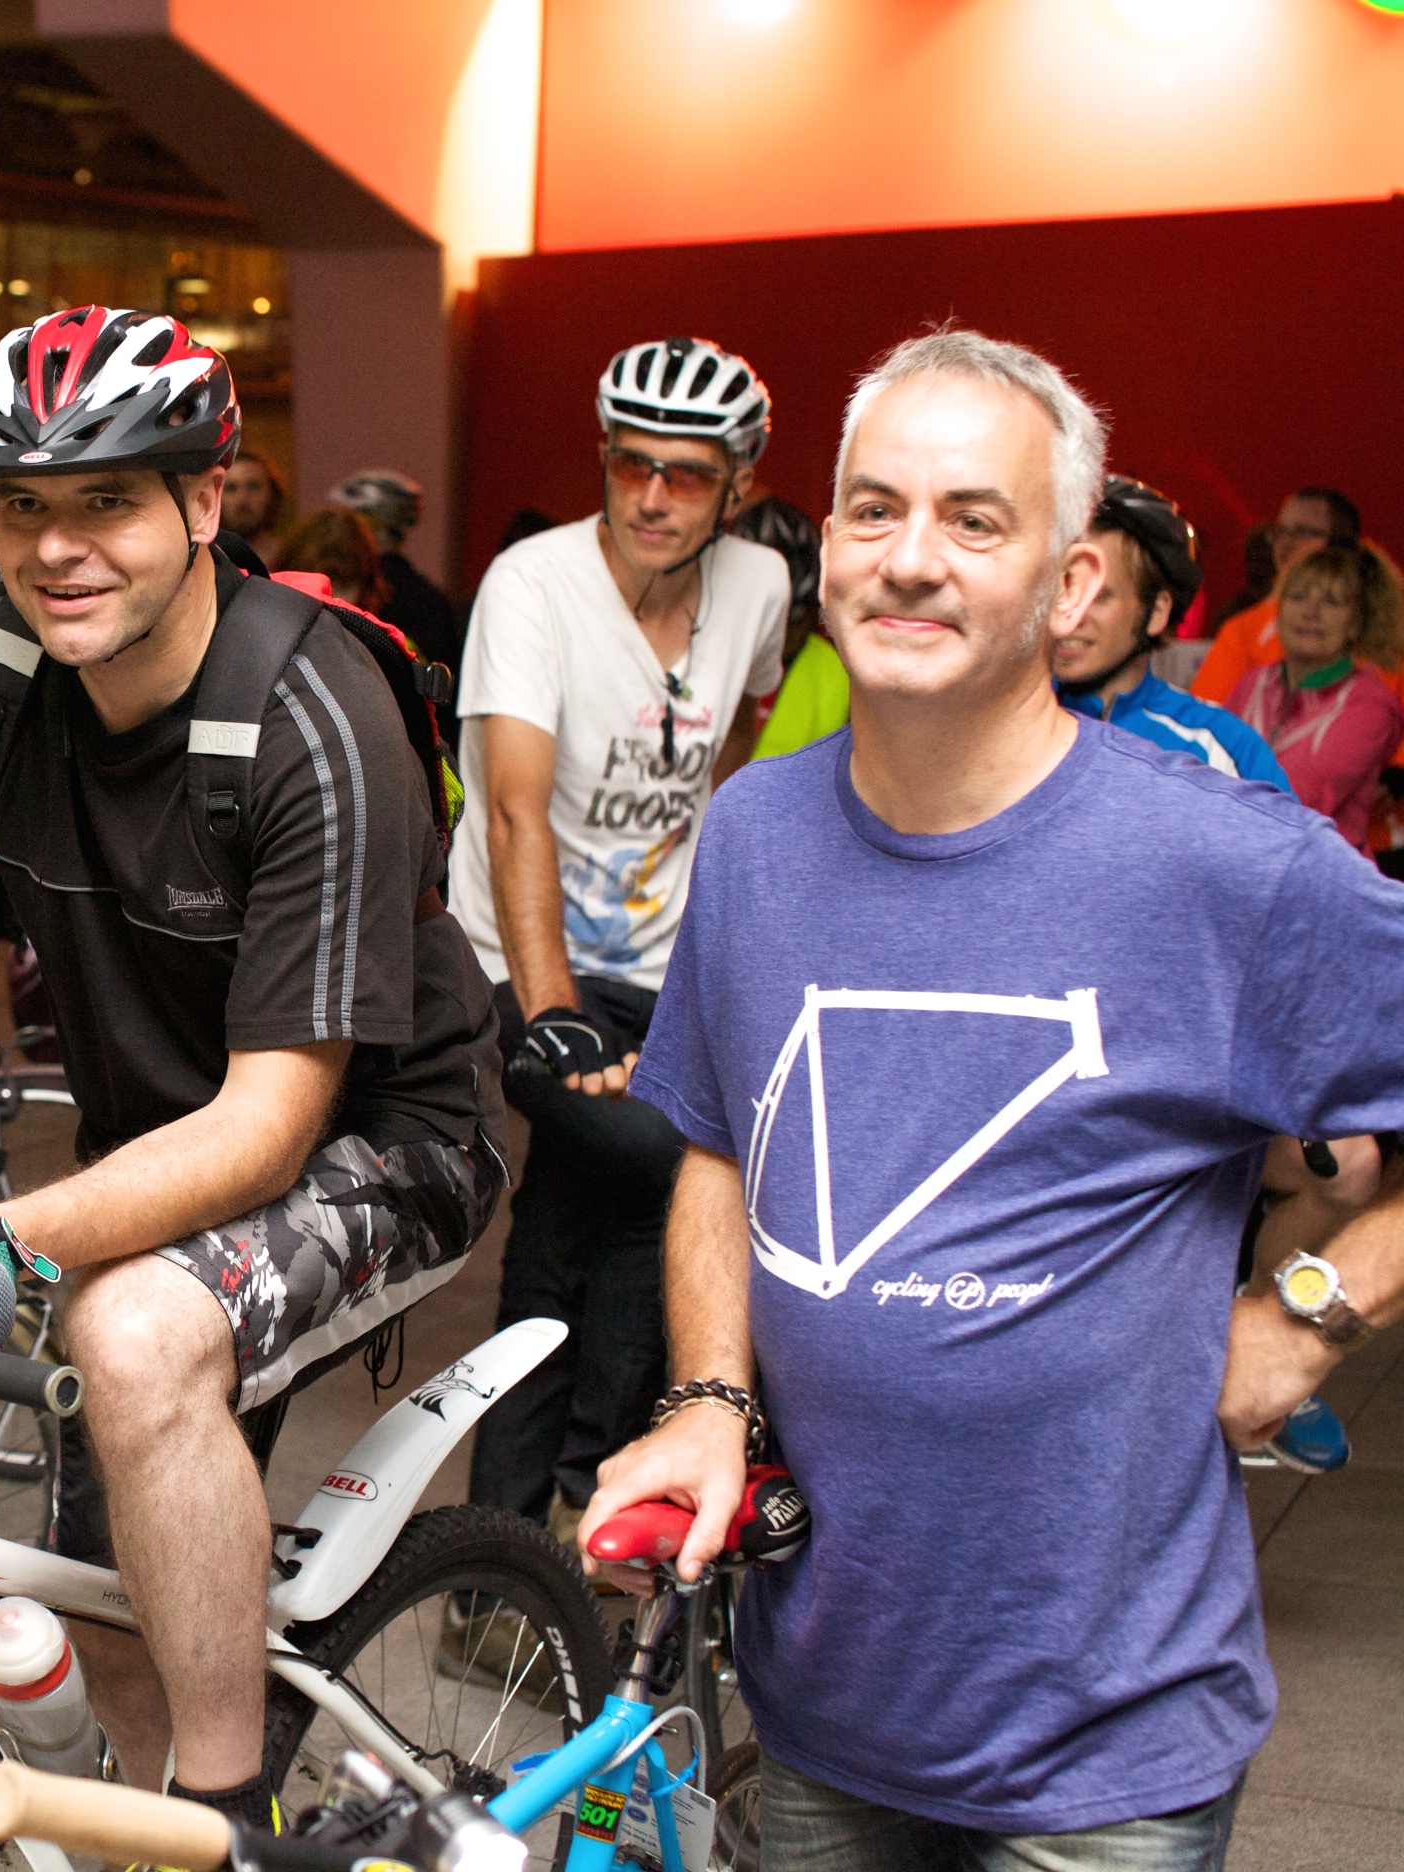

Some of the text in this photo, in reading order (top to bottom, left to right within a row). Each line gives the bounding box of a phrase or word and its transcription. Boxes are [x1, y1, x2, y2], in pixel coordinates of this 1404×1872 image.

[165, 884, 228, 910] LONSDALE
[872, 1272, 943, 1307] cycling
[986, 1273, 1054, 1307] peopl
[321, 1474, 368, 1496] BELL
[579, 1801, 619, 1829] 501
